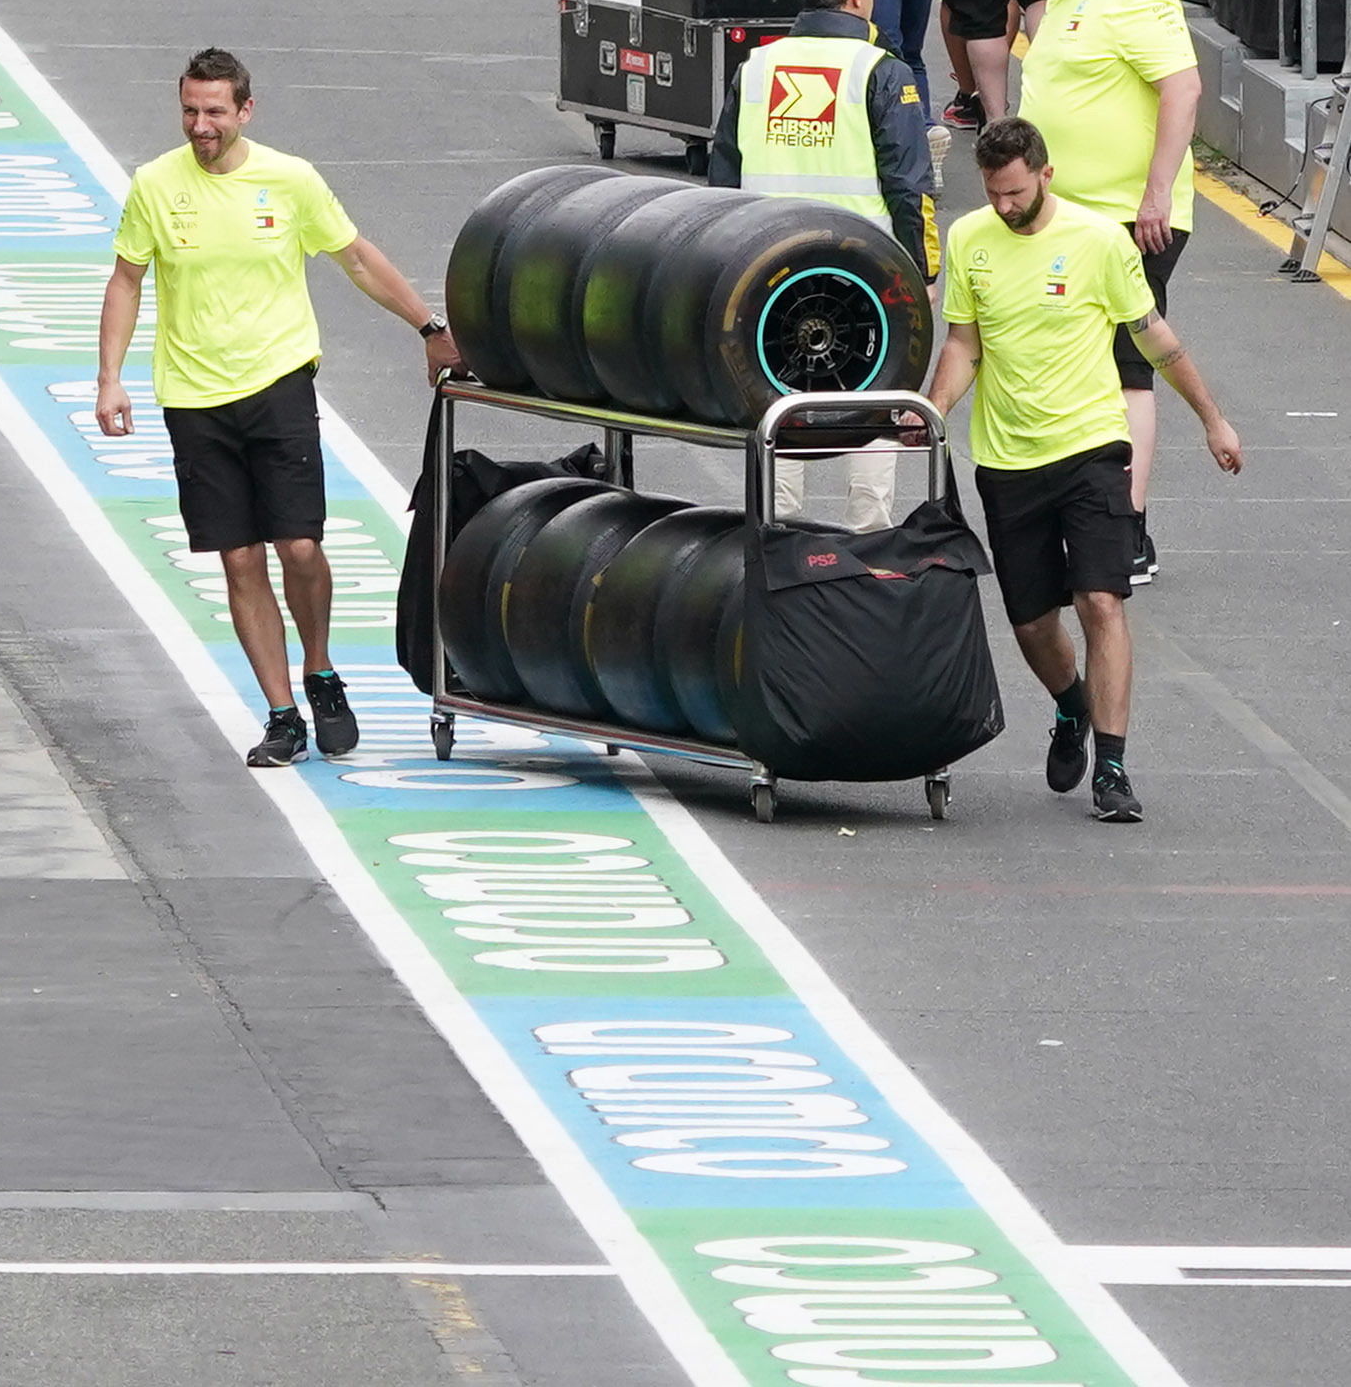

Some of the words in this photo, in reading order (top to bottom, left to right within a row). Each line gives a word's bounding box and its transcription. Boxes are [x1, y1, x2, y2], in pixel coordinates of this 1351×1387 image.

[768, 118, 833, 136] GIBSON
[765, 133, 836, 148] FREIGHT
[806, 552, 839, 567] PS2
[386, 830, 730, 972] aramco
[530, 1019, 909, 1179] aramco
